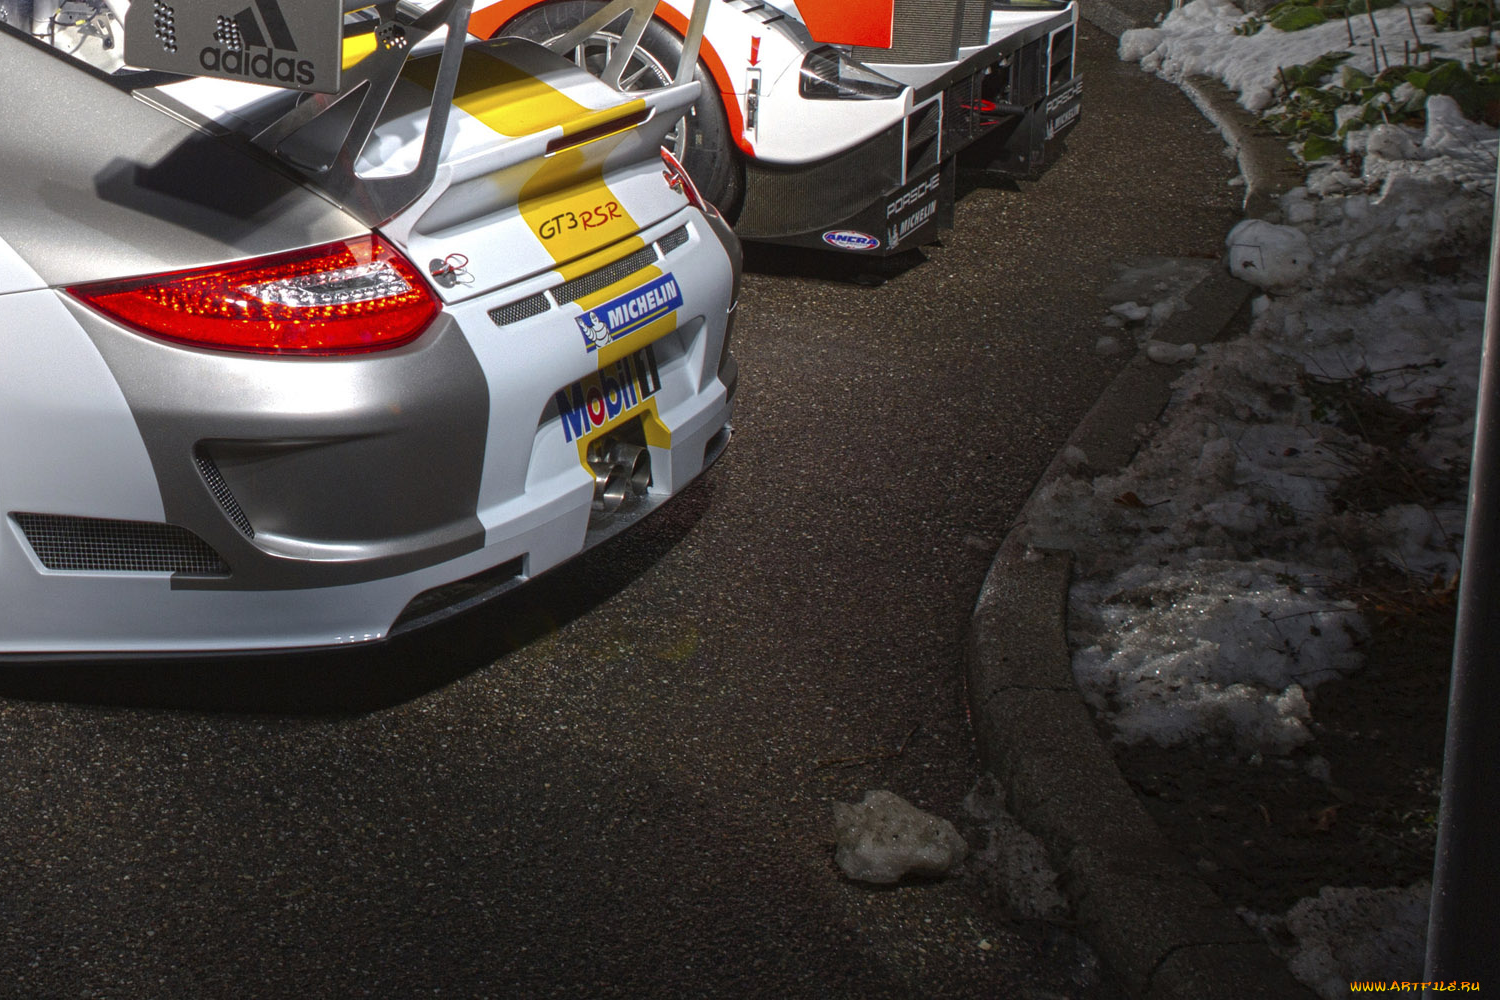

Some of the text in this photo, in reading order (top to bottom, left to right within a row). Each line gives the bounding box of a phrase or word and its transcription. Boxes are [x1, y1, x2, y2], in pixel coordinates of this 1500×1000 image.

[200, 45, 315, 85] adidas
[1046, 81, 1084, 114] PORSCHE
[886, 173, 940, 219] PORSCHE
[900, 200, 937, 235] MICHELIN
[826, 233, 879, 246] ANCRA
[607, 280, 678, 330] MICHELIN
[555, 355, 639, 443] Mobil
